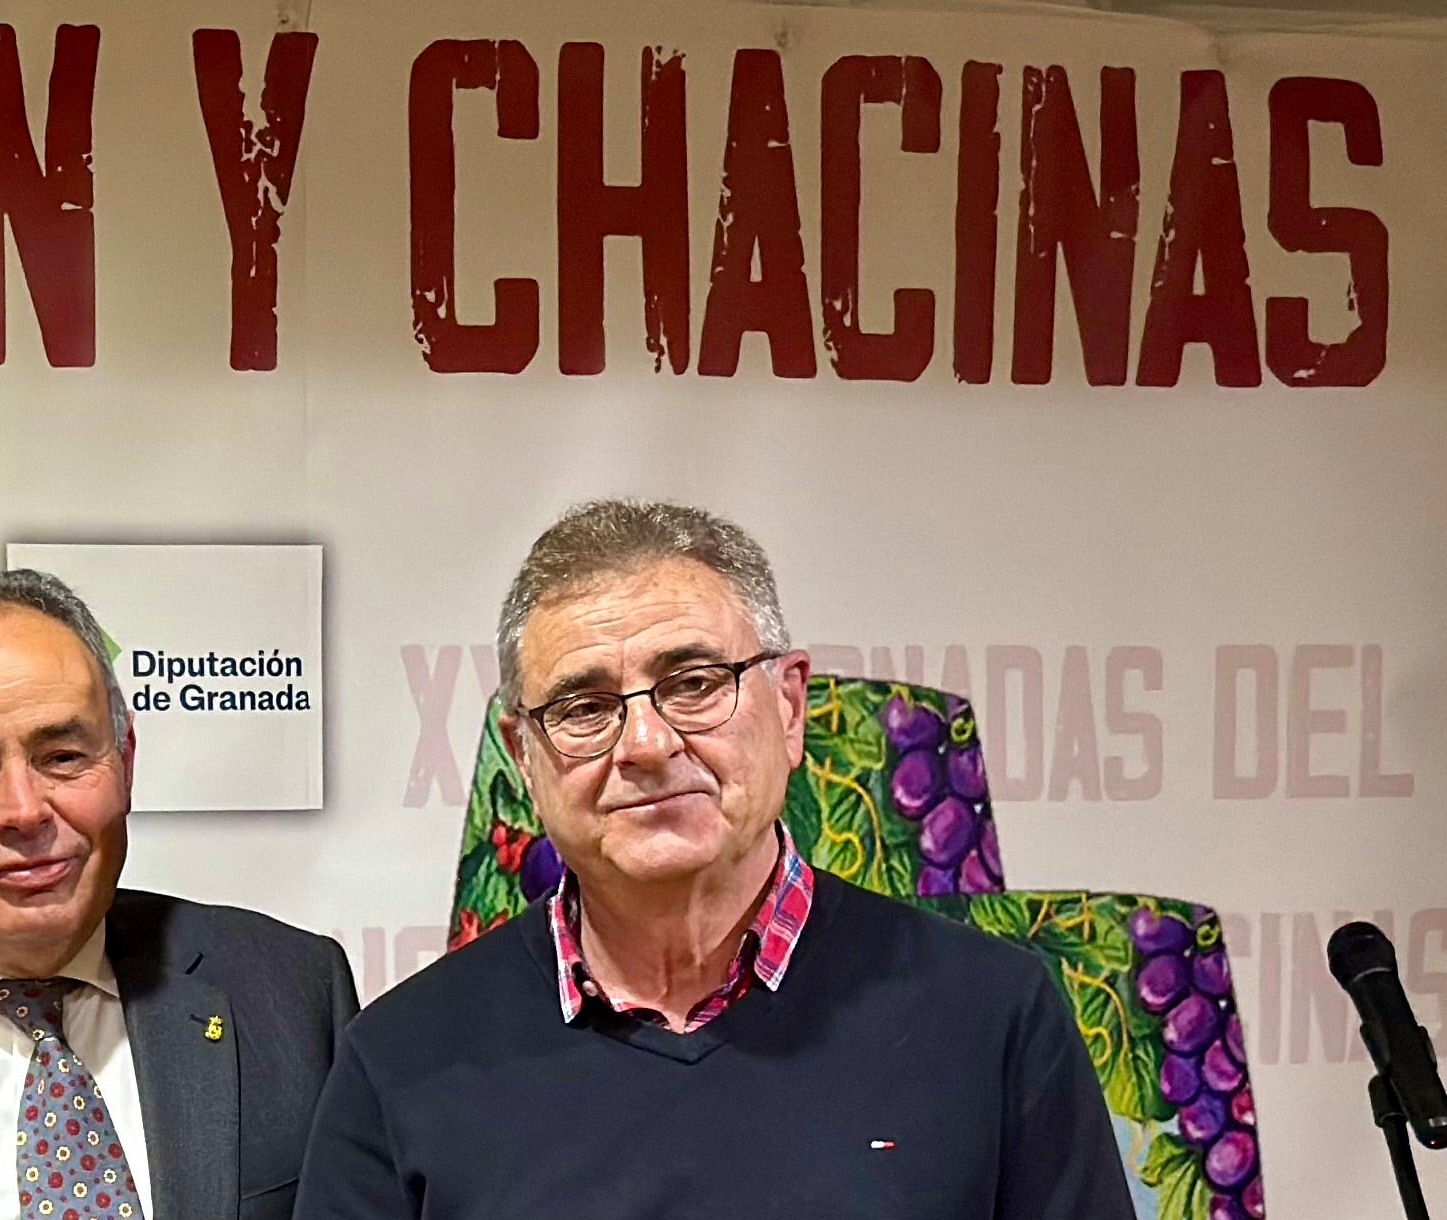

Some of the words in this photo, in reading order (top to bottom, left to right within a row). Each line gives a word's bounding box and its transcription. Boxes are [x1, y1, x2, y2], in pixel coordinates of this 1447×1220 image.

[192, 28, 319, 371] Y
[409, 38, 1390, 388] CHACINAS
[132, 649, 303, 684] Diputación
[132, 684, 171, 711] de
[179, 683, 311, 711] Granada
[1211, 642, 1416, 800] DEL
